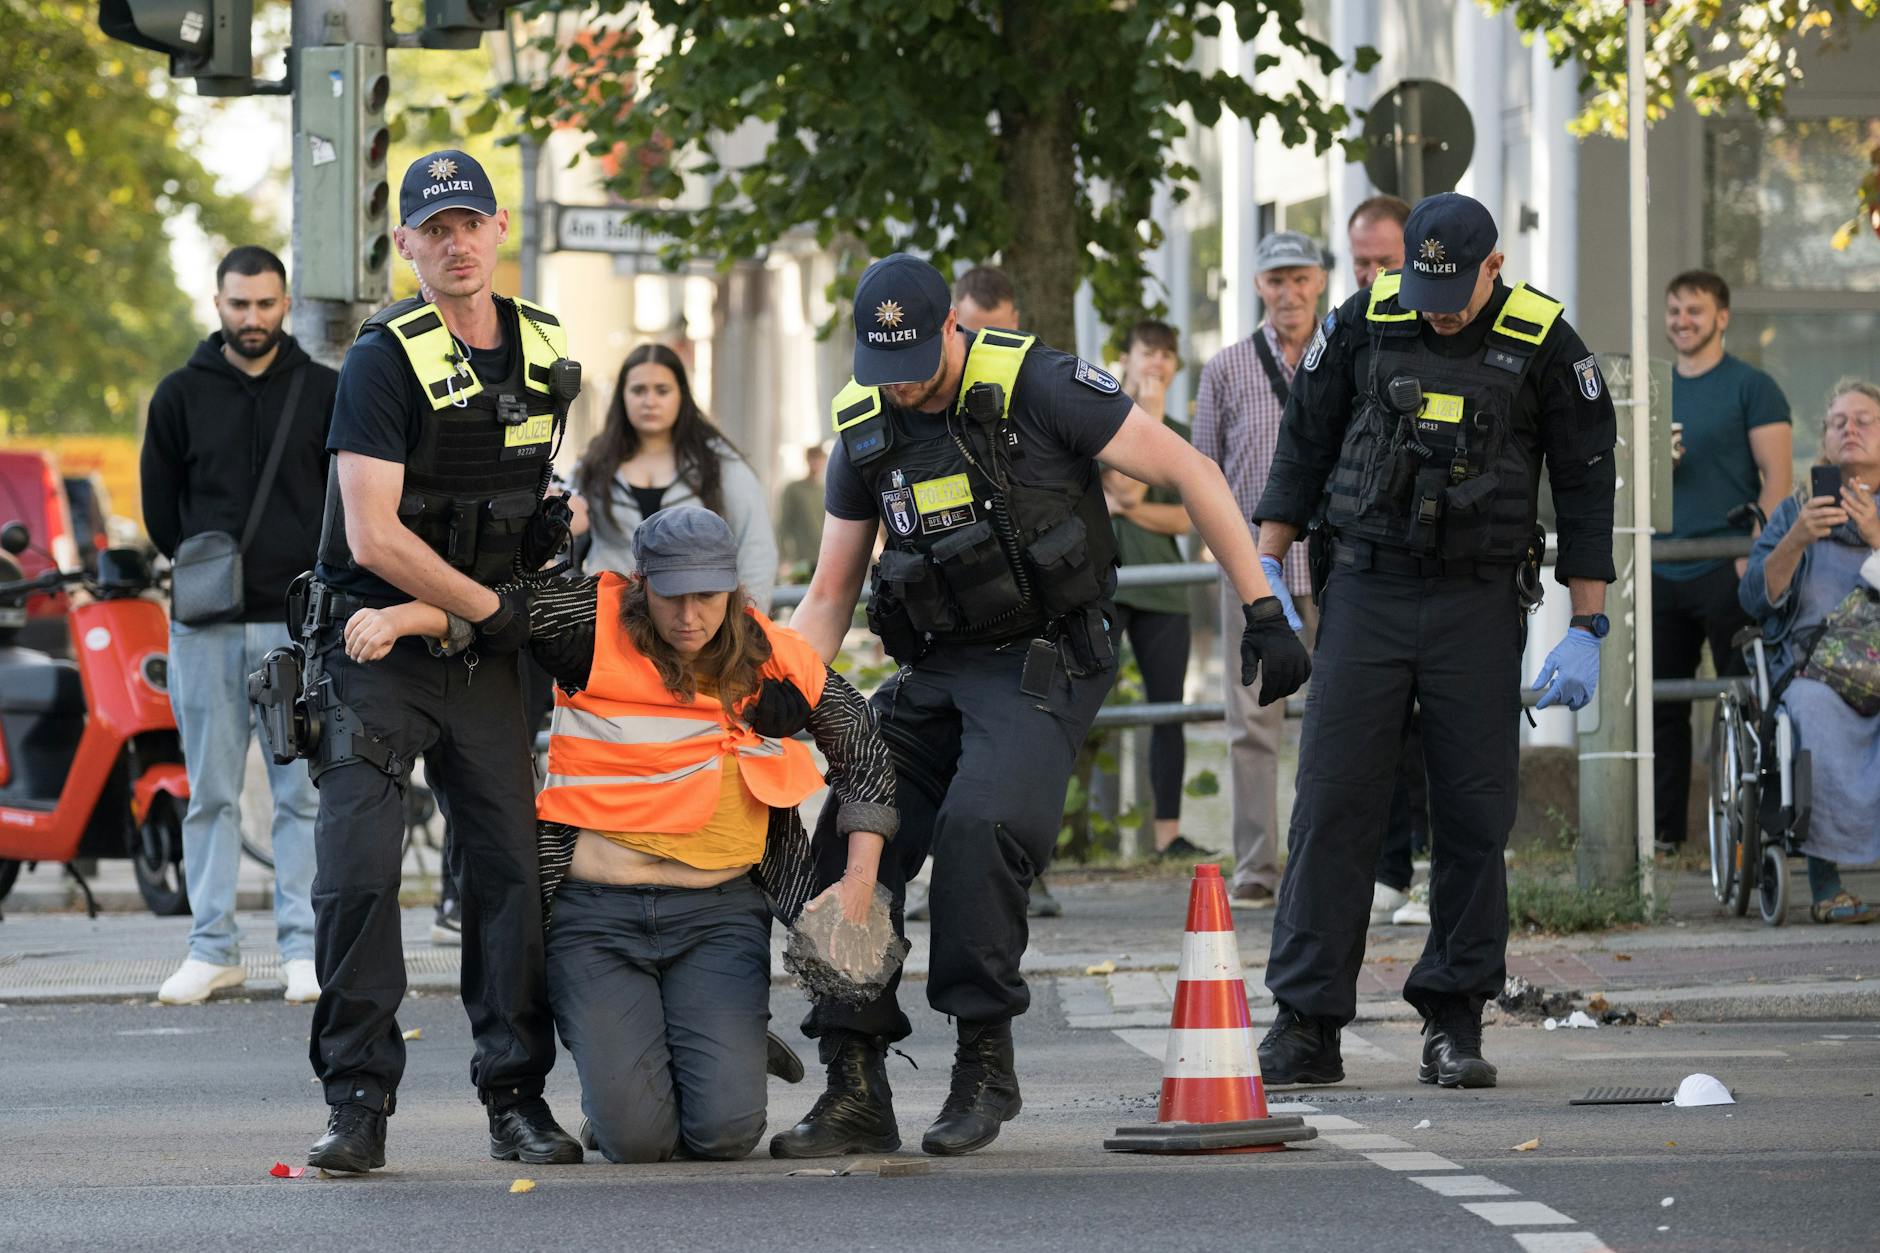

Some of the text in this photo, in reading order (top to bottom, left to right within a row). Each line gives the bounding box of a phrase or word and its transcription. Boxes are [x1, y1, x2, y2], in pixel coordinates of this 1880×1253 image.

[422, 180, 473, 199] POLIZEI
[1413, 260, 1456, 273] POLIZEI
[868, 328, 917, 342] POLIZEI
[509, 420, 552, 441] POLIZEI
[917, 479, 969, 505] POLIZEI
